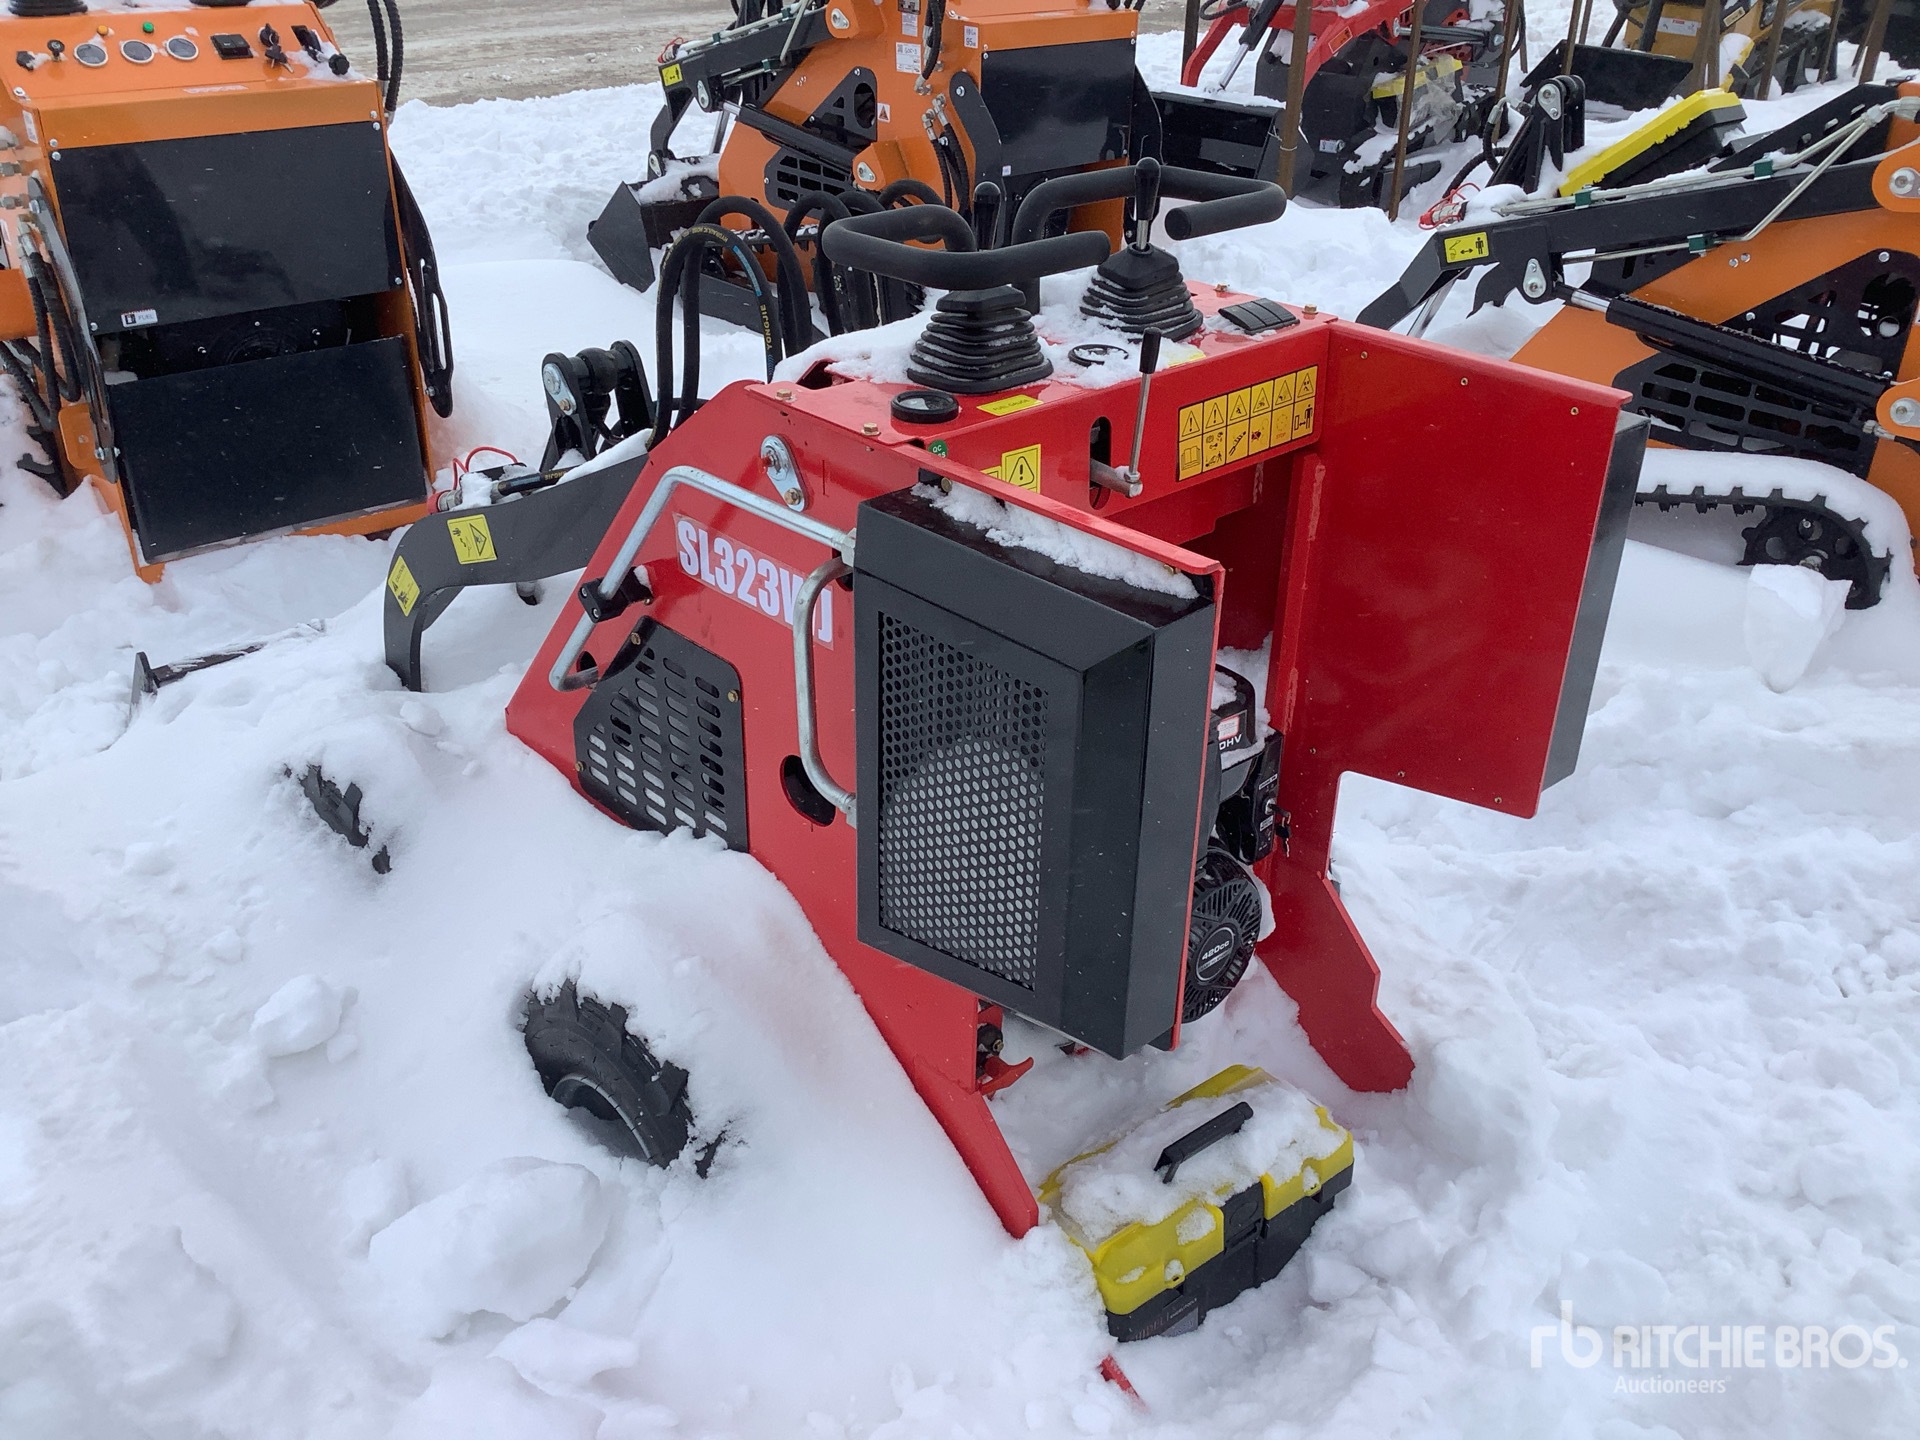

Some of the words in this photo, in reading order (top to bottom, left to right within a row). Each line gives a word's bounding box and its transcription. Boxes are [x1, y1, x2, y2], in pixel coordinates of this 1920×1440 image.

[138, 313, 154, 321] FUEL
[760, 304, 773, 350] YONGJIE
[932, 444, 942, 453] QC
